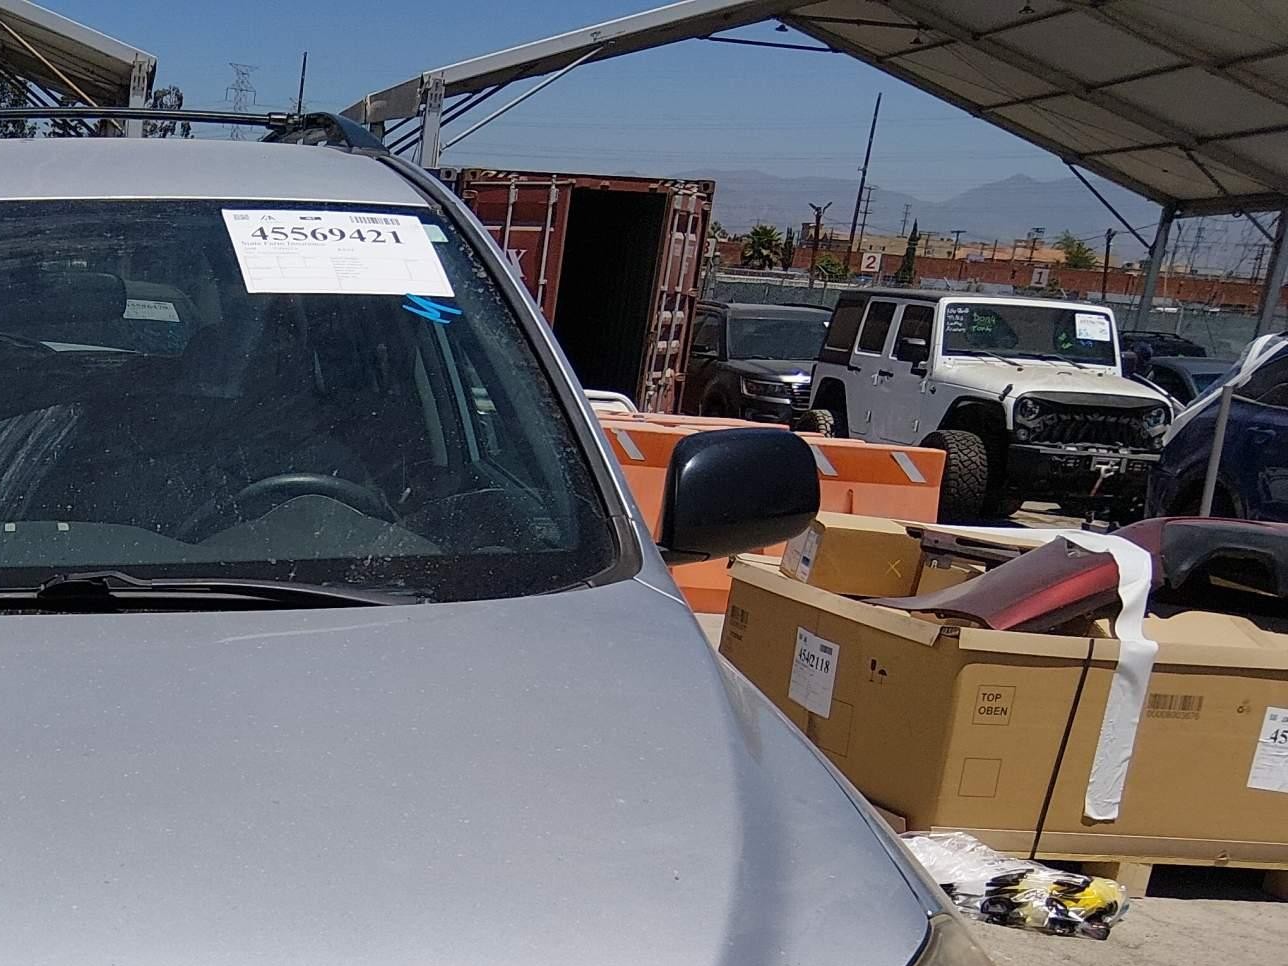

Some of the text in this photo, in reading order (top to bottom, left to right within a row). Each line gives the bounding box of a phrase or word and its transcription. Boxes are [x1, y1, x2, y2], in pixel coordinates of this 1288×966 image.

[251, 226, 405, 245] 45569421
[865, 255, 877, 269] 2
[1035, 271, 1044, 284] 1
[981, 693, 1002, 702] TOP
[978, 706, 1008, 716] OBEN
